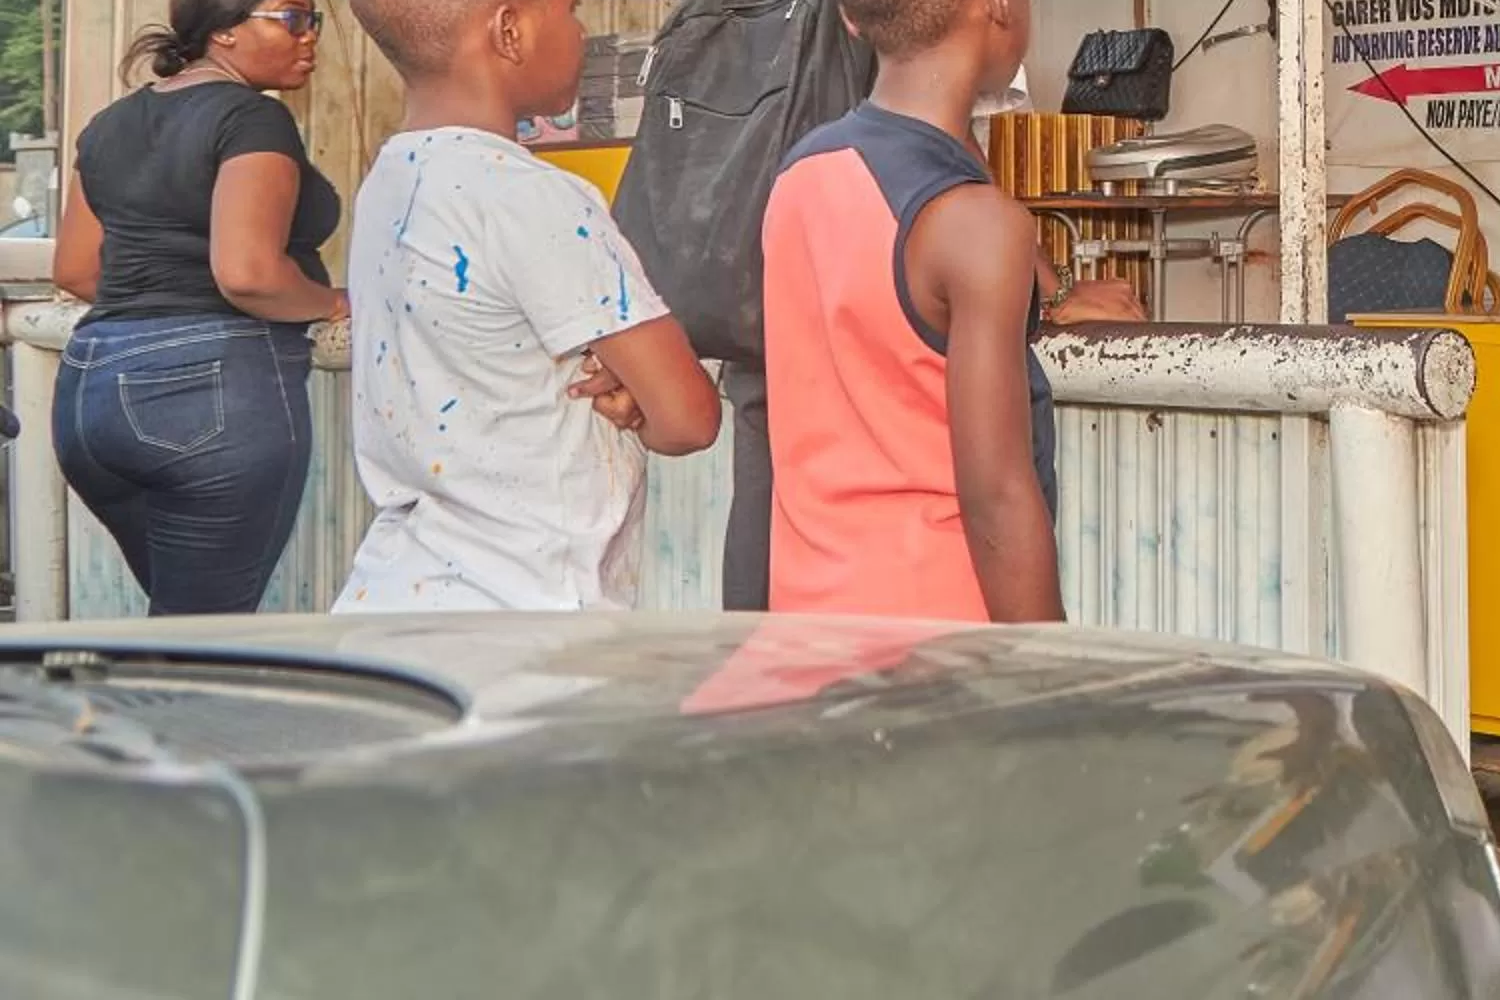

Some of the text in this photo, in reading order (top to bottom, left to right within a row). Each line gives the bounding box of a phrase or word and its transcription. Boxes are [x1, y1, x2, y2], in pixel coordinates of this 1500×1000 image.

[1332, 35, 1350, 63] AU
[1353, 30, 1414, 62] PARKING
[1417, 25, 1482, 57] RESERVE
[1426, 100, 1455, 128] NON
